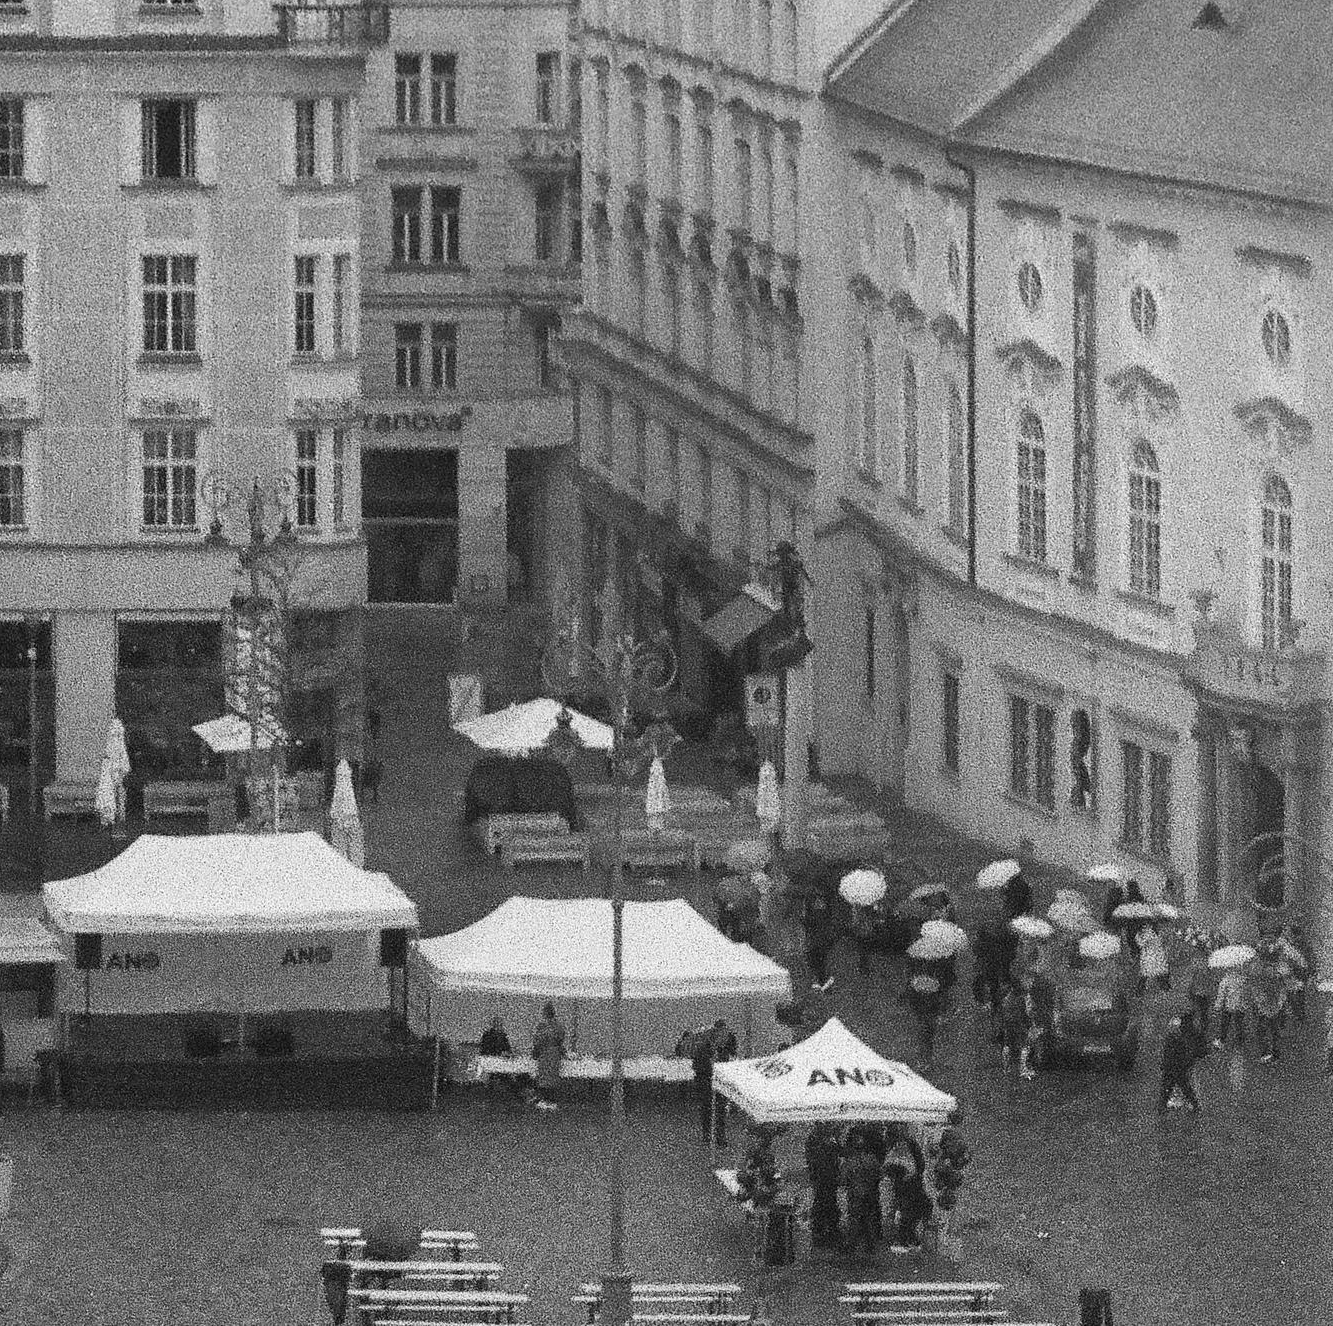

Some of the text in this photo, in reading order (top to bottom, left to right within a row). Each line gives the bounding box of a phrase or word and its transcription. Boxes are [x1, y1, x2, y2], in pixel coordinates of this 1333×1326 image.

[106, 952, 161, 971] ANO
[282, 946, 333, 966] ANO
[807, 1067, 895, 1088] ANO
